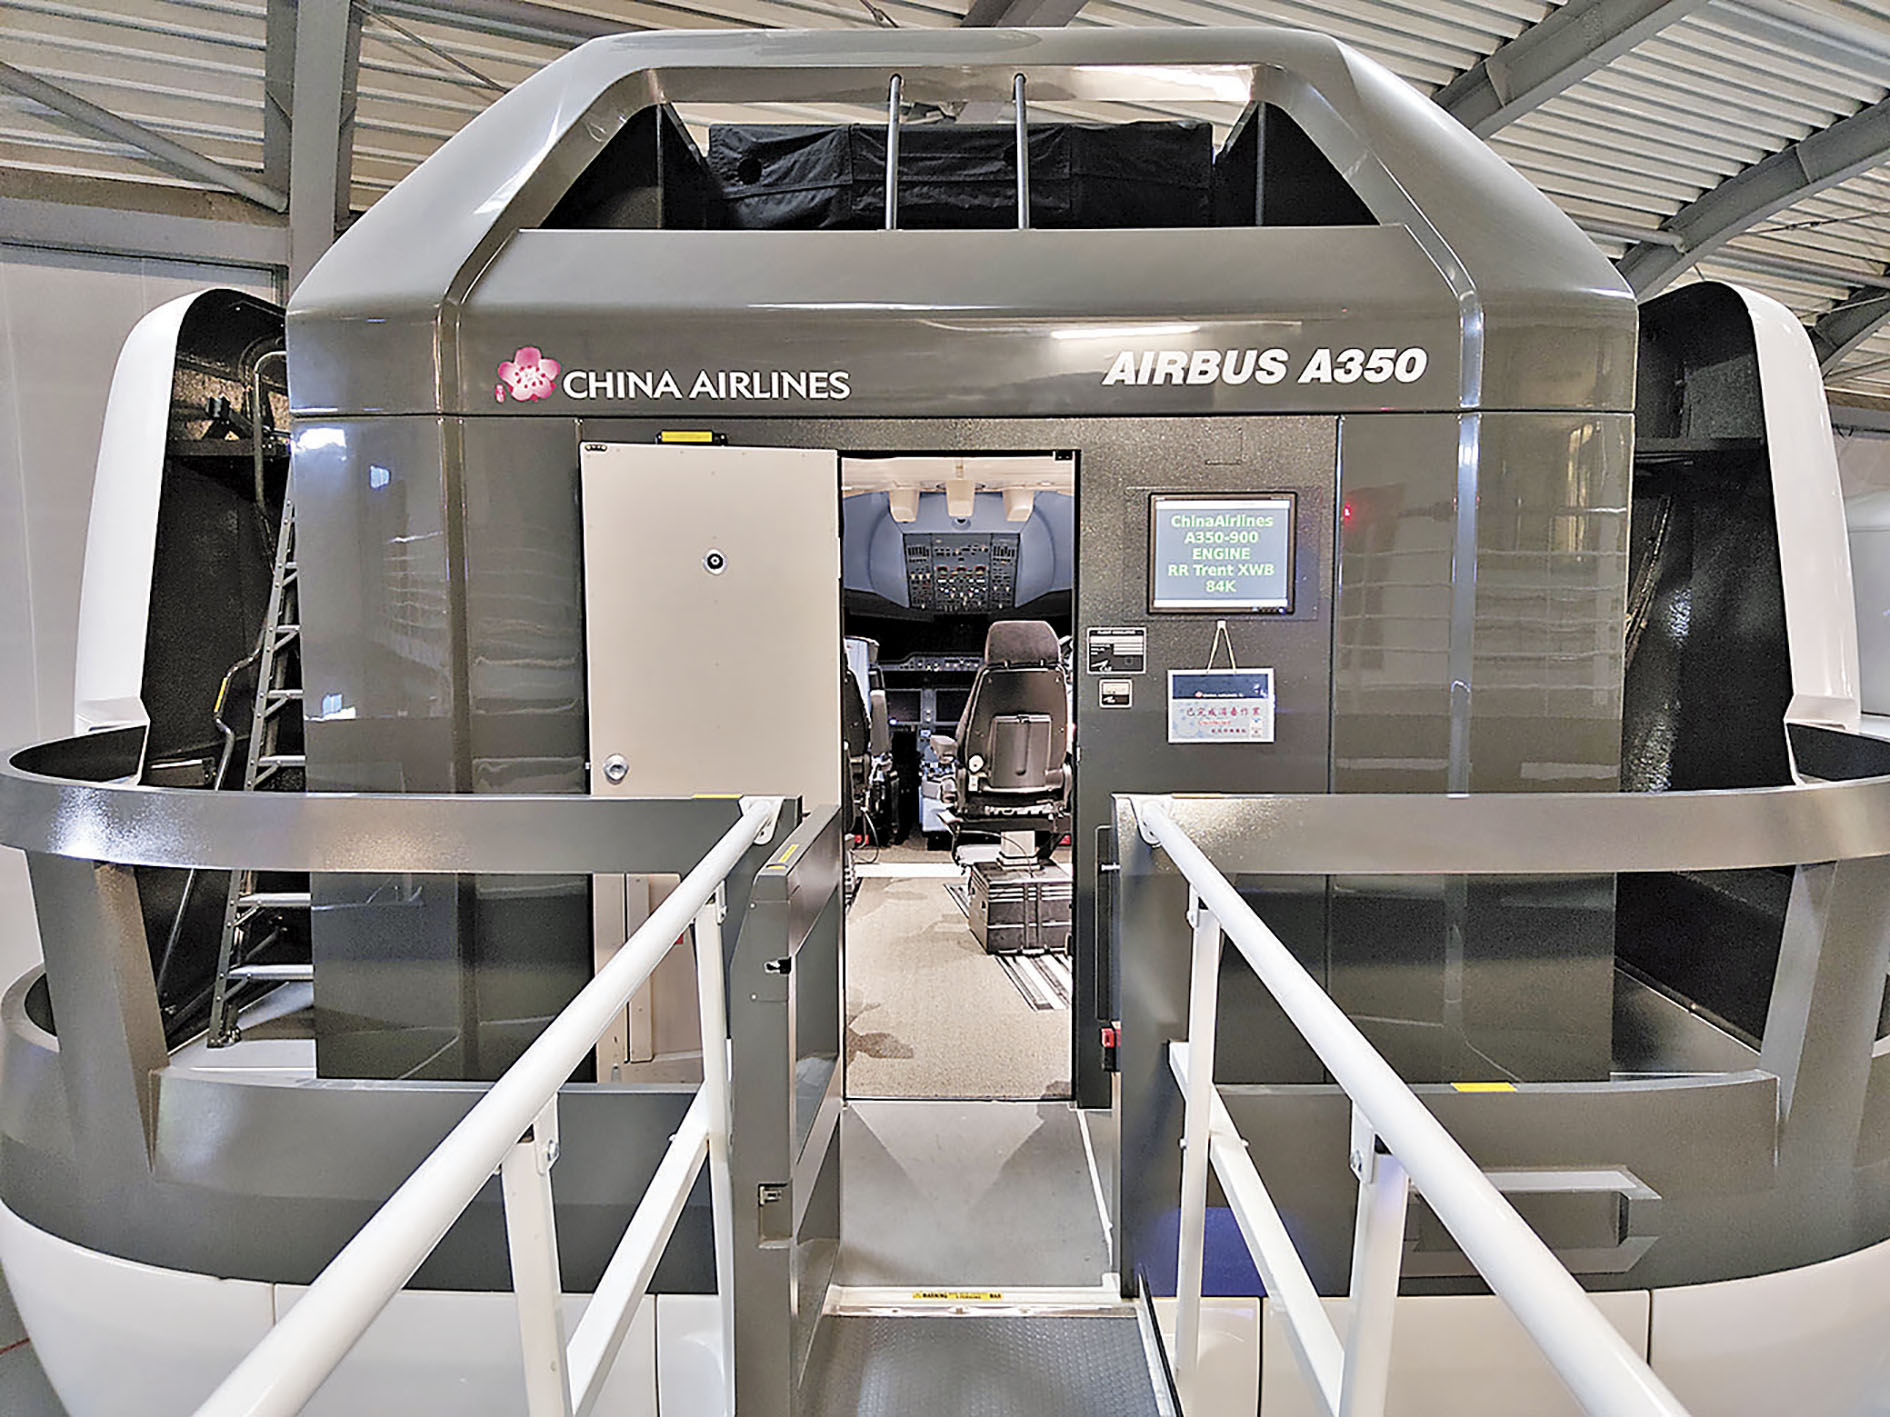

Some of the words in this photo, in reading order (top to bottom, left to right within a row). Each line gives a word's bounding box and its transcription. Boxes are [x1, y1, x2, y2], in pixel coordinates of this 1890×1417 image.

[1101, 348, 1289, 385] AIRBUS
[1297, 347, 1428, 384] A350
[562, 369, 683, 399] CHINA
[689, 369, 851, 399] AIRLINES
[1171, 515, 1274, 528] ChinaAirlines
[1184, 531, 1259, 544] A350-900
[1192, 547, 1251, 560] ENGINE
[1168, 564, 1189, 577] RR
[1193, 564, 1234, 577] Trent
[1238, 563, 1275, 576] XWB
[1206, 580, 1237, 593] 84K
